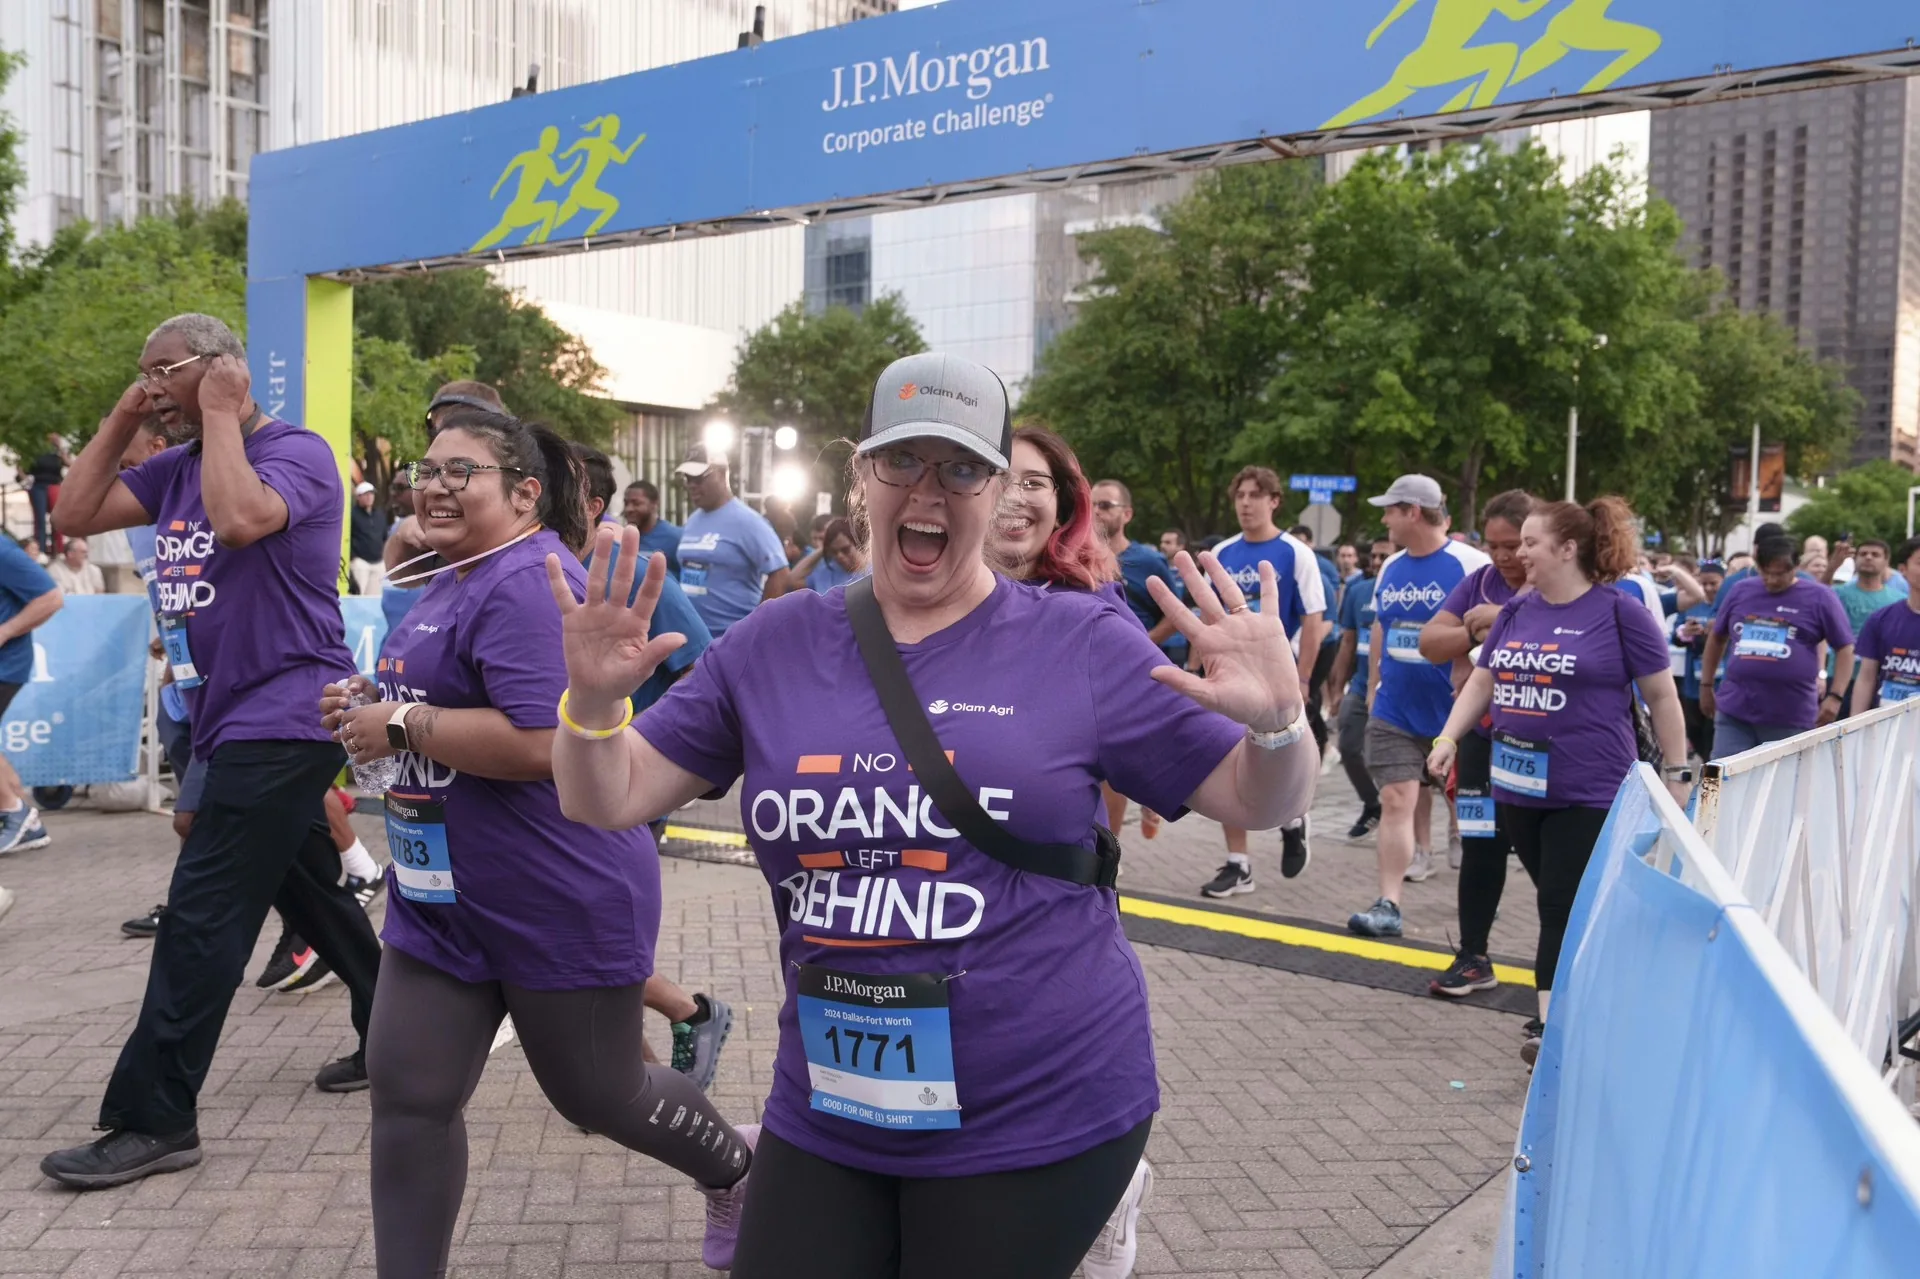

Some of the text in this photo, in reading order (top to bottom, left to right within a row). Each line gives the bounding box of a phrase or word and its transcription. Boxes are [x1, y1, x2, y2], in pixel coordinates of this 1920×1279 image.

[822, 37, 1050, 111] J.P.Morgan
[823, 119, 926, 153] Corporate
[269, 352, 286, 420] J.P.M
[920, 386, 978, 407] Olam Agri
[1382, 586, 1442, 602] Berkshire
[1396, 635, 1418, 648] 193
[1523, 642, 1540, 651] NO
[1514, 673, 1535, 682] LEFT
[1493, 682, 1567, 711] BEHIND
[951, 702, 1015, 716] Olam Agri
[852, 753, 897, 773] NO
[1500, 753, 1536, 775] 1775
[391, 831, 430, 867] 1783
[844, 850, 899, 870] LEFT
[777, 868, 985, 940] BEHIND
[823, 974, 907, 1004] J.P.Morgan
[824, 1008, 912, 1027] 2024 Dallas-Fort Worth
[825, 1025, 916, 1074] 1771
[822, 1096, 842, 1112] GOOD
[843, 1103, 858, 1115] FOR
[859, 1107, 874, 1119] ONE
[875, 1111, 885, 1123] (1)
[886, 1114, 914, 1125] SHIRT
